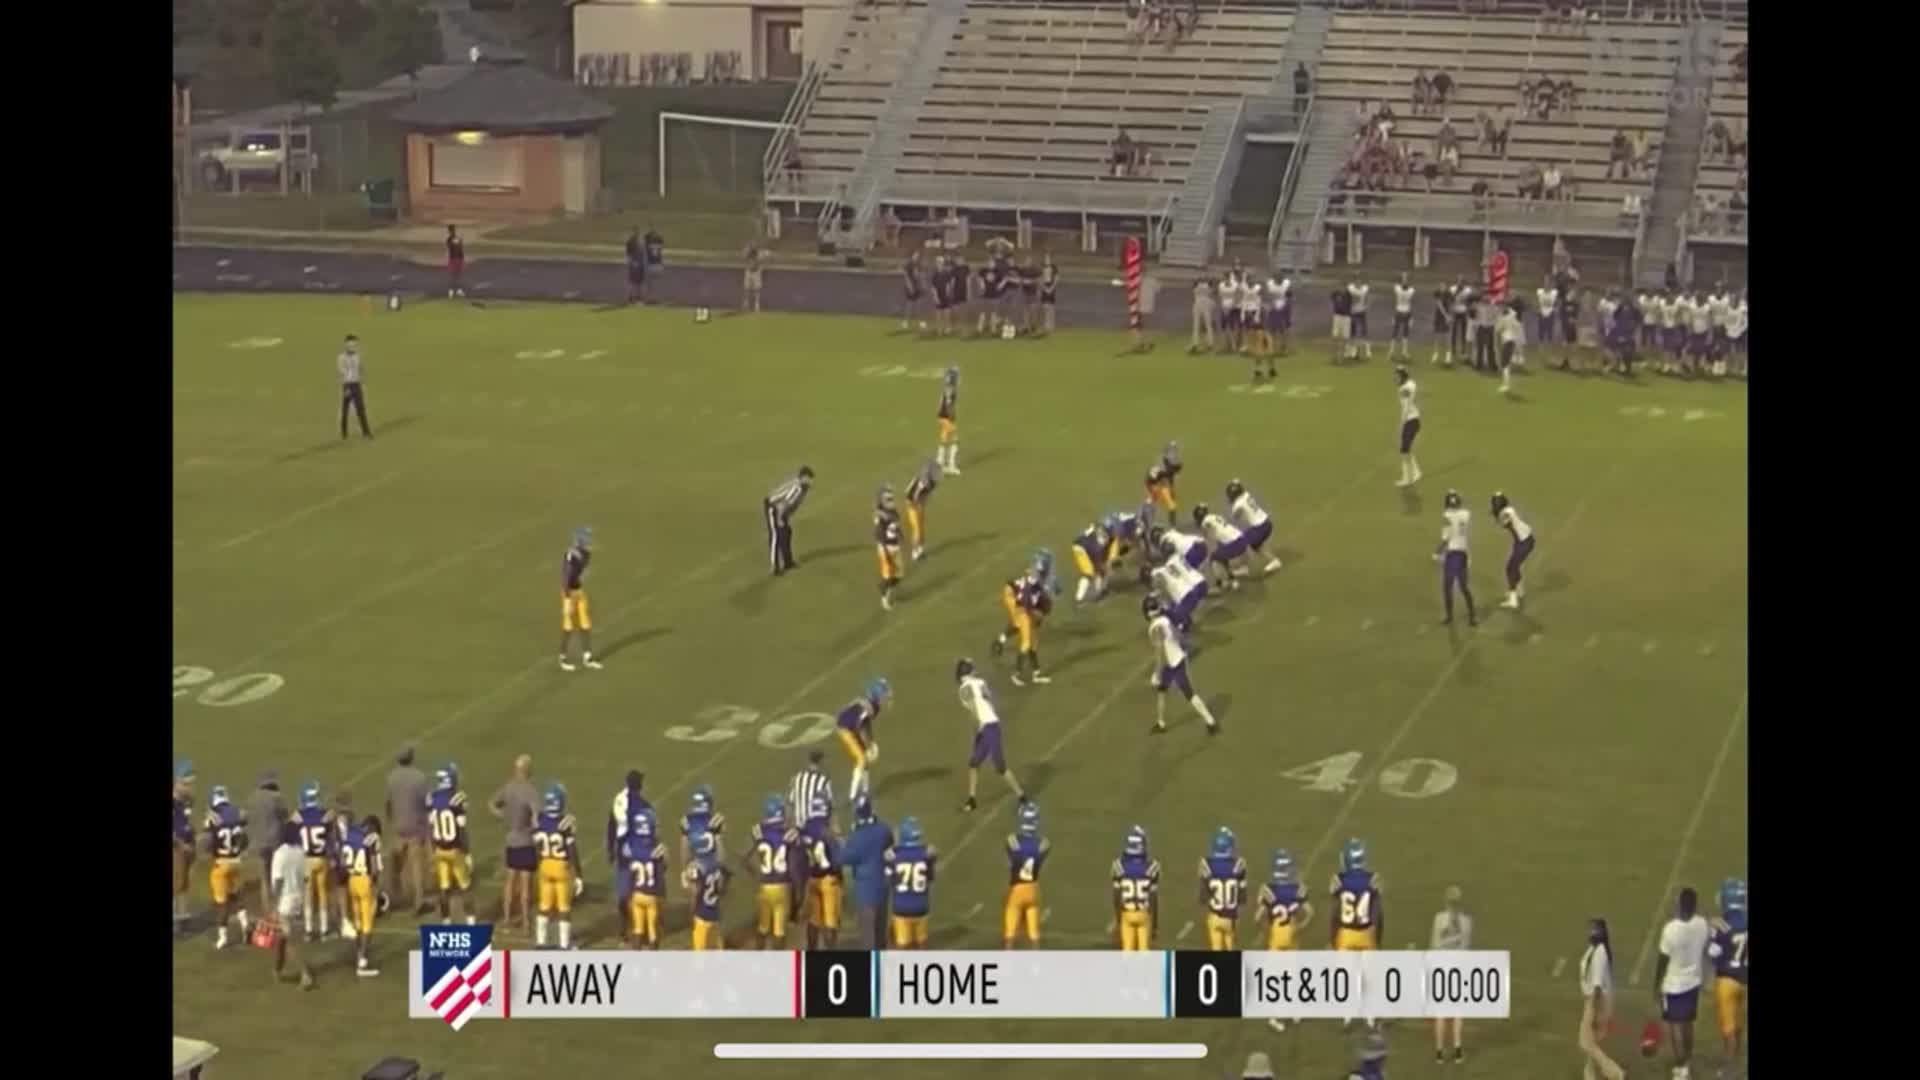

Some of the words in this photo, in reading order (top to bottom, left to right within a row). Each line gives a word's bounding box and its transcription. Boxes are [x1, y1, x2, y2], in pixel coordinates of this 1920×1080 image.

[664, 704, 836, 748] 30
[1280, 751, 1458, 798] 40
[300, 826, 327, 853] 15
[429, 809, 457, 841] 10
[896, 861, 927, 892] 76
[1209, 878, 1238, 910] 30
[1340, 891, 1370, 924] 64
